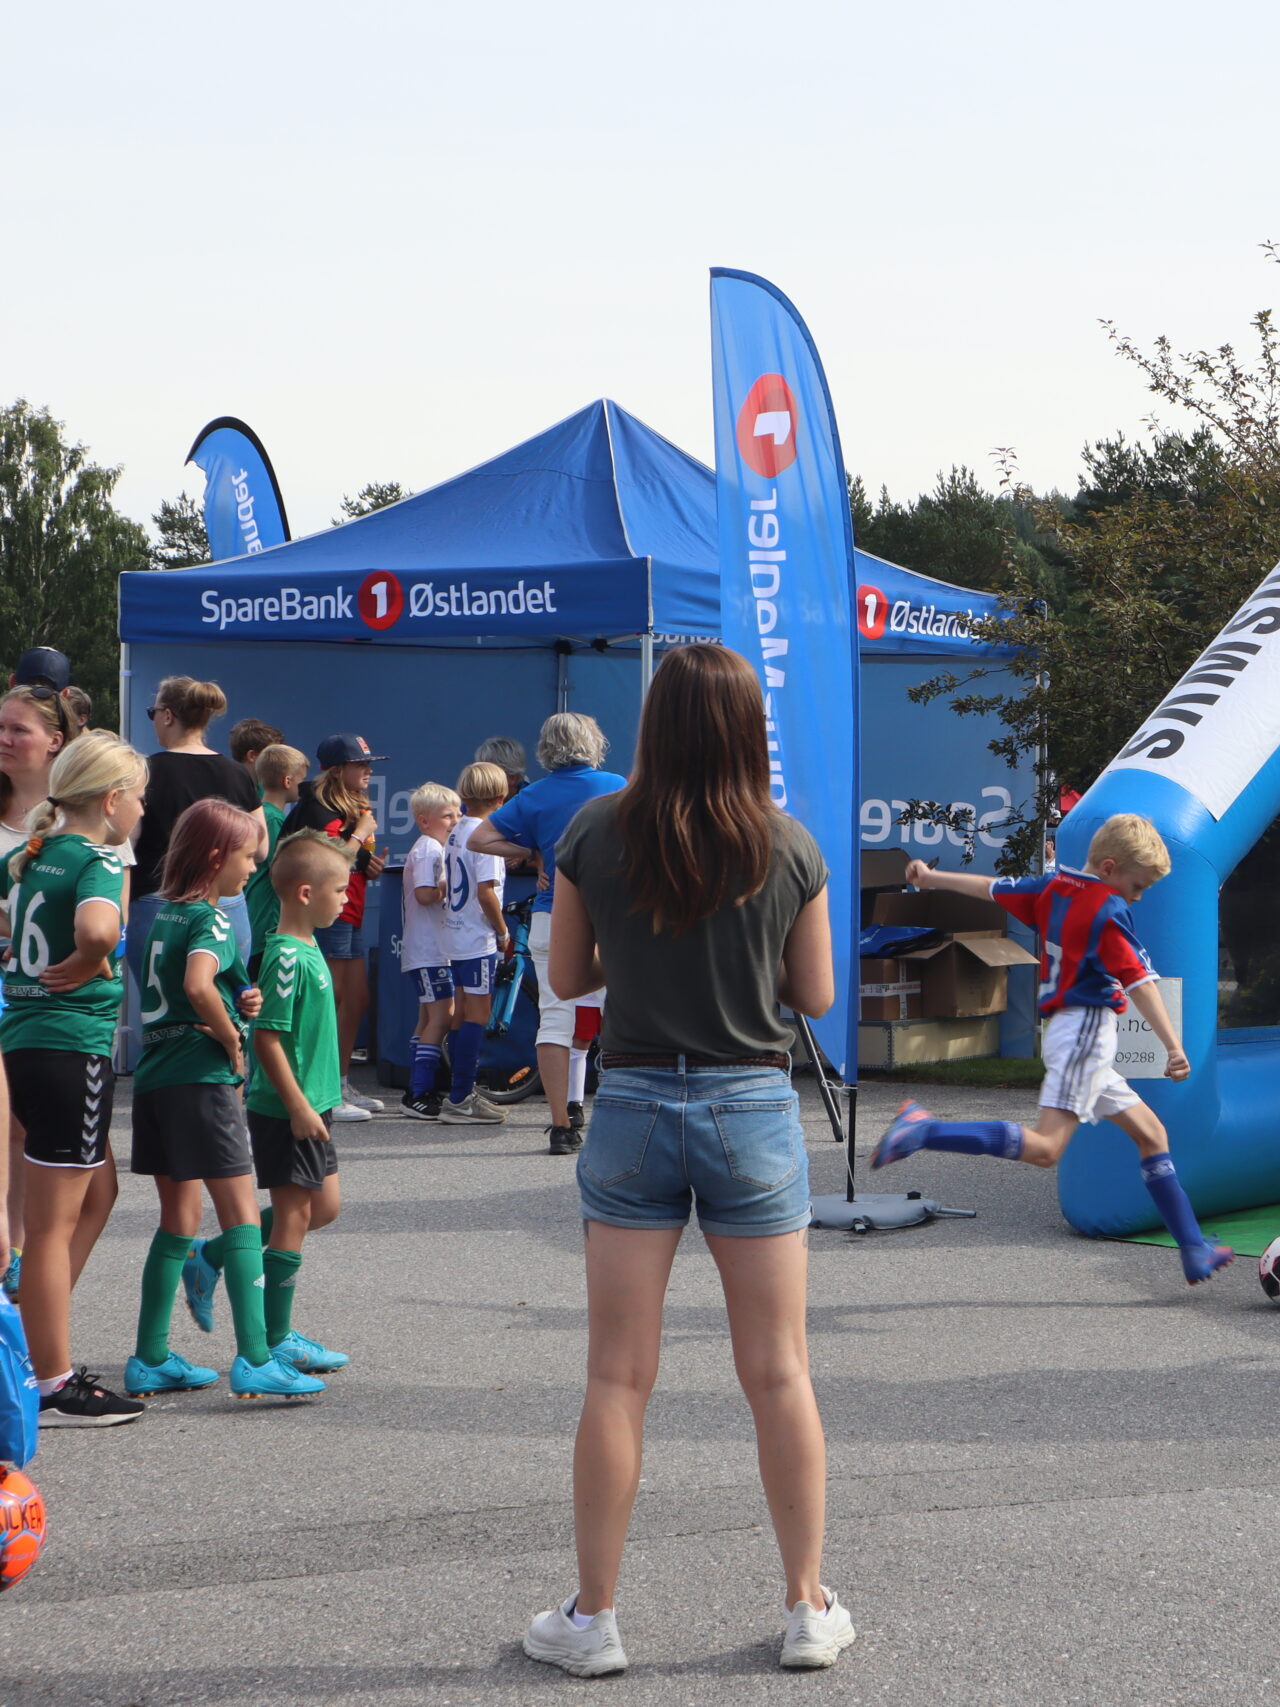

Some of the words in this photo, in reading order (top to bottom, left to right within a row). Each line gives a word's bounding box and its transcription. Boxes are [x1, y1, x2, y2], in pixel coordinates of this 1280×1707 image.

[201, 585, 354, 630] SpareBank
[371, 581, 388, 619] 1
[409, 580, 557, 618] Østlandet
[864, 593, 878, 629] 1
[1115, 1051, 1155, 1064] 09288
